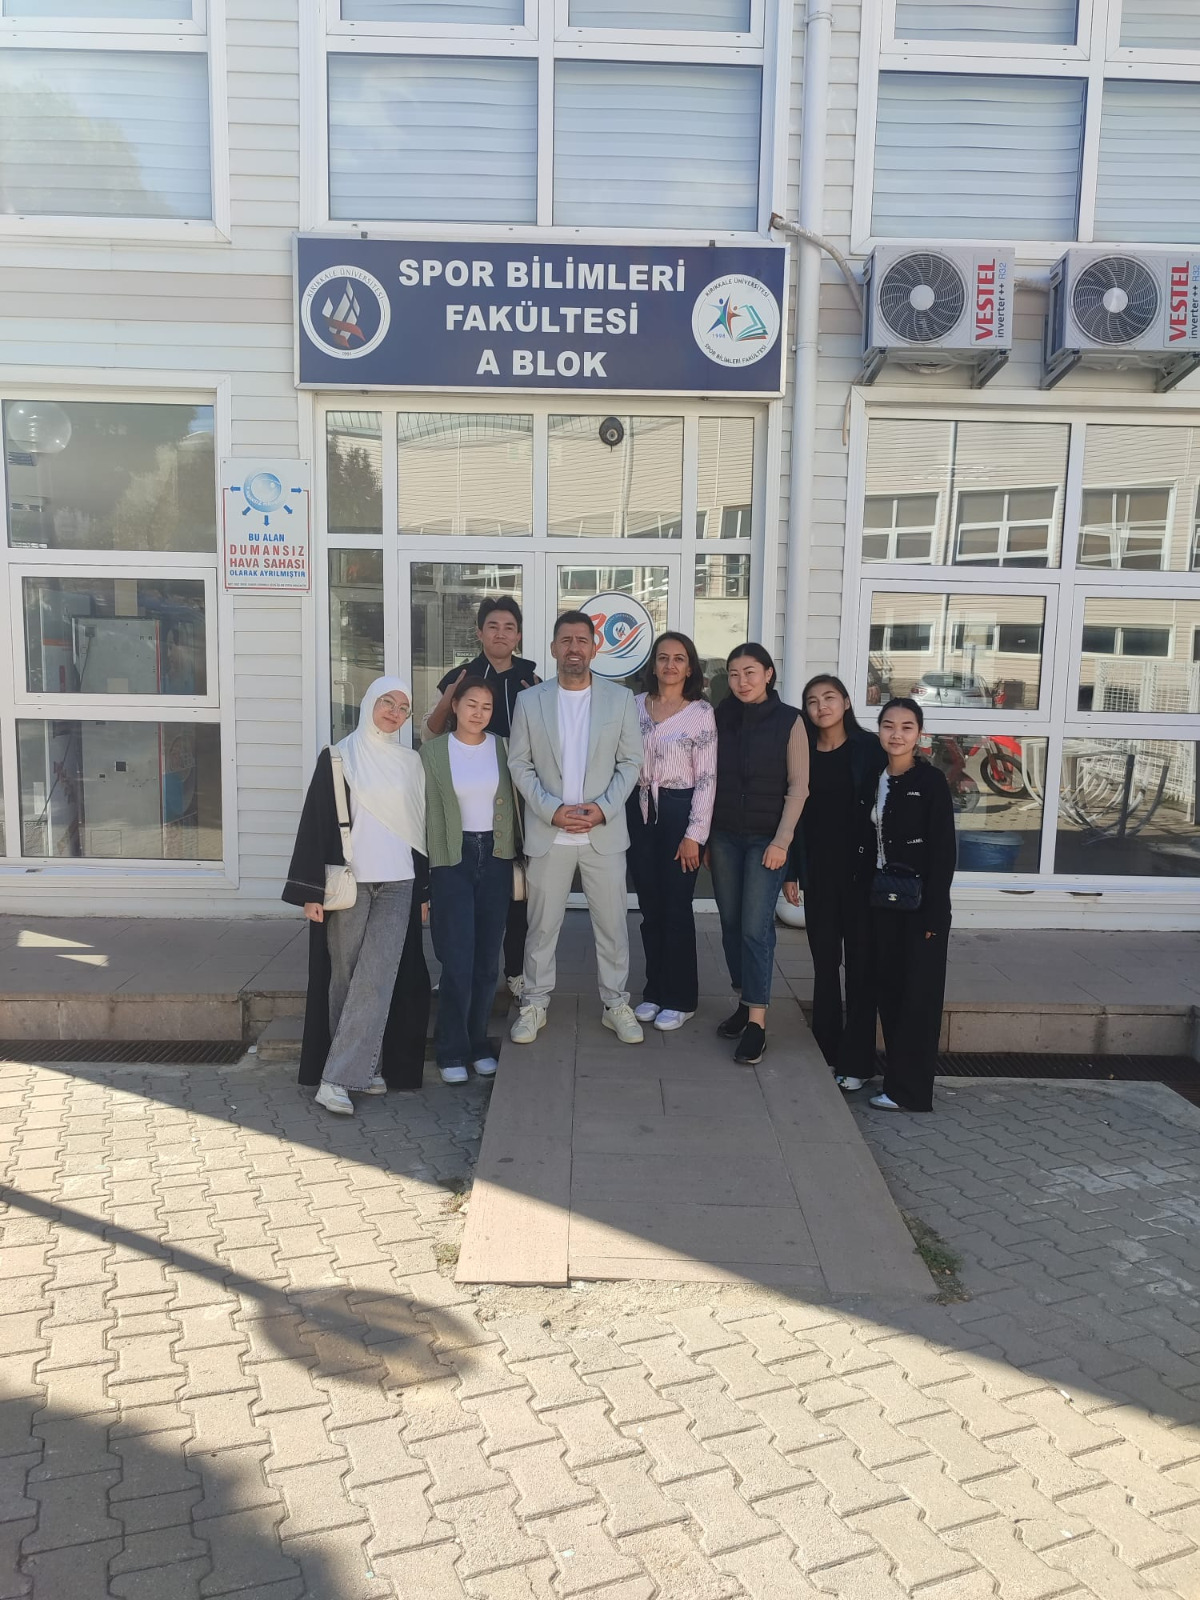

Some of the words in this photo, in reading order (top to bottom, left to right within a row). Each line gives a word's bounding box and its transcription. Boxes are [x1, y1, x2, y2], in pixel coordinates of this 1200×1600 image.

[399, 259, 495, 287] SPOR
[507, 255, 686, 292] BİLİMLERİ
[998, 262, 1007, 280] R32
[975, 258, 996, 341] VESTEL
[1169, 260, 1190, 342] VESTEL
[446, 300, 638, 335] FAKÜLTESİ
[476, 349, 501, 375] A
[512, 350, 608, 377] BLOK
[248, 533, 260, 542] BU
[262, 533, 285, 542] ALAN
[230, 544, 305, 557] DUMANSIZ
[229, 569, 258, 577] OLARAK
[259, 570, 306, 578] AYRILMIŞTIR
[230, 557, 260, 568] HAVA
[263, 558, 305, 569] SAHASI
